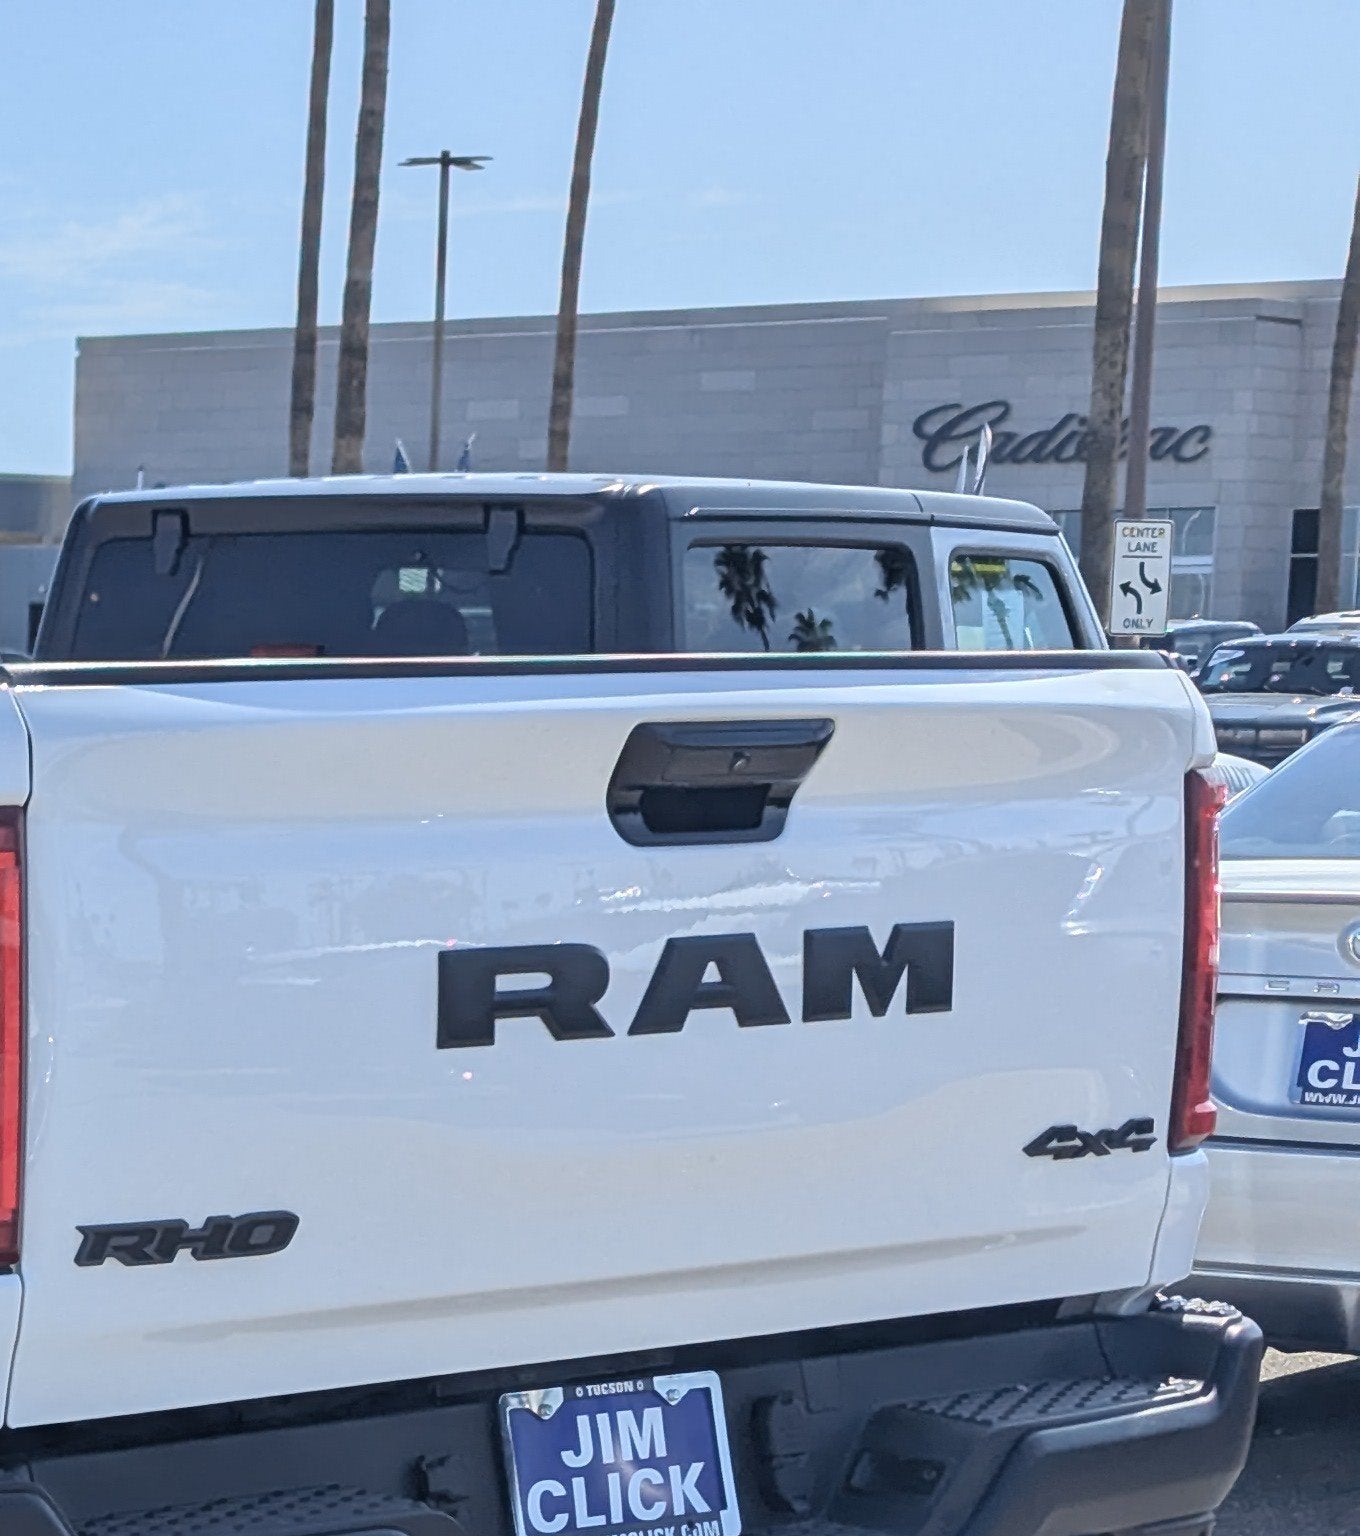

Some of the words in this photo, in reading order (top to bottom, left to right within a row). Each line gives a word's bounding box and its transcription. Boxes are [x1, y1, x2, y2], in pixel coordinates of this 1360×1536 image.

[1121, 526, 1166, 539] CENTER
[1127, 541, 1159, 553] LANE
[1122, 617, 1154, 630] ONLY
[436, 920, 955, 1049] RAM
[74, 1209, 300, 1267] RHO
[585, 1380, 634, 1397] TUCSON
[560, 1406, 668, 1468] JIM
[527, 1461, 712, 1534] CLICK
